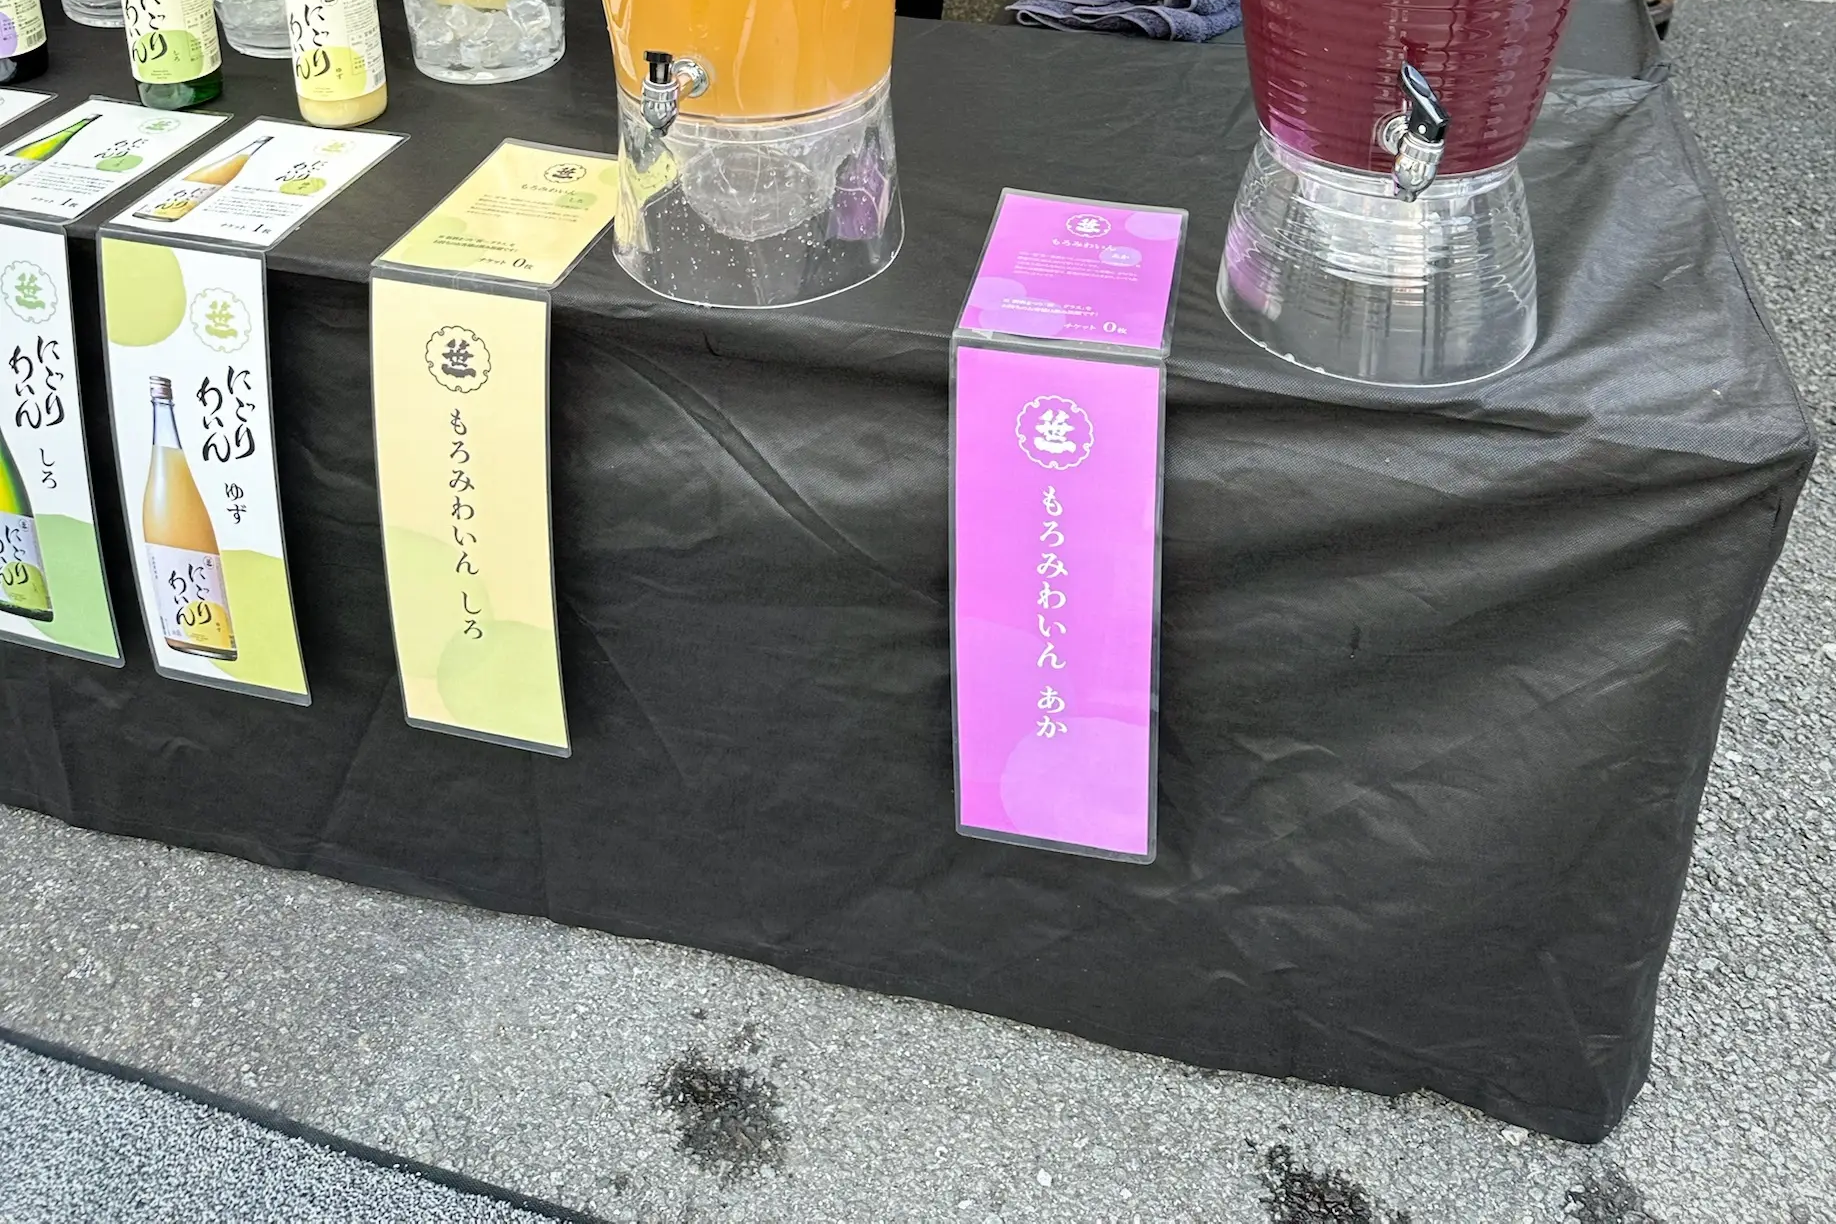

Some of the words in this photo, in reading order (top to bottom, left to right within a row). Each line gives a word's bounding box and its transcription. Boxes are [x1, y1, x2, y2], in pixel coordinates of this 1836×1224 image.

[290, 13, 310, 79] わいん
[305, 4, 331, 77] にごり
[1052, 238, 1117, 251] もろみわいん
[8, 345, 42, 429] わいん
[37, 335, 65, 427] にごり
[227, 366, 256, 460] にごり
[196, 376, 231, 463] わいん
[40, 447, 57, 489] しろ
[449, 408, 479, 576] もろみわいん
[224, 482, 247, 525] ゆず
[168, 570, 196, 627] わいん
[188, 563, 212, 625] にごり
[1036, 485, 1068, 670] もろみわいん
[461, 591, 483, 640] しろ
[1035, 686, 1068, 739] あか
